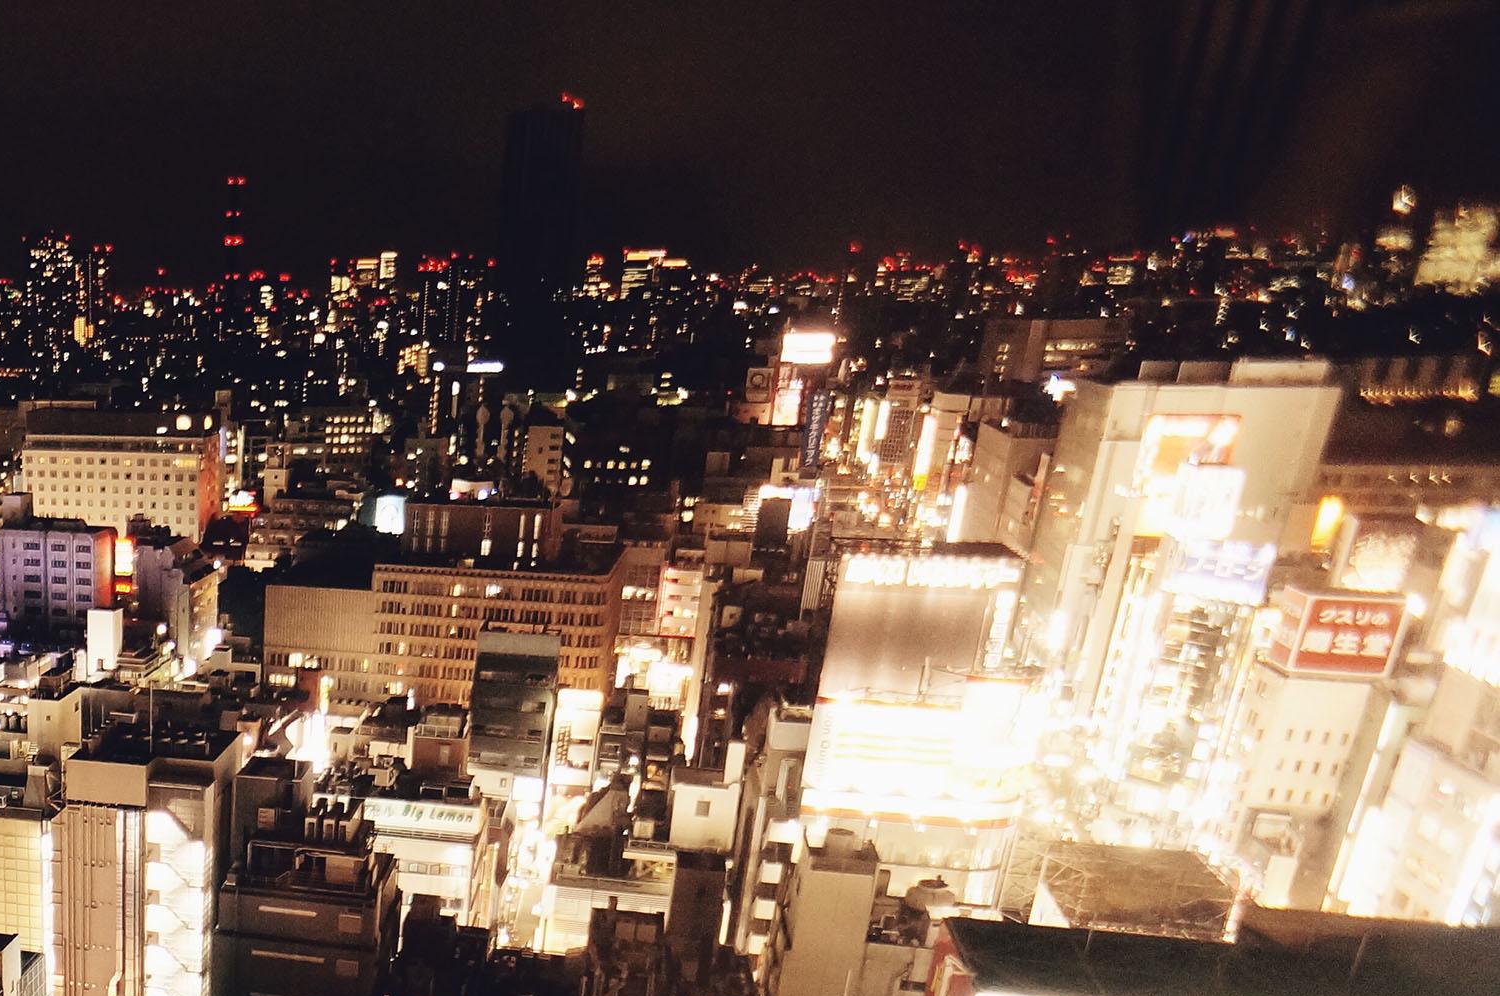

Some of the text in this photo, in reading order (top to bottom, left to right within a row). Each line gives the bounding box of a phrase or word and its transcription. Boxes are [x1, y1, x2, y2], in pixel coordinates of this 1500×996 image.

[1318, 607, 1390, 626] クスリの
[402, 804, 424, 822] Big
[429, 806, 473, 823] Lemon
